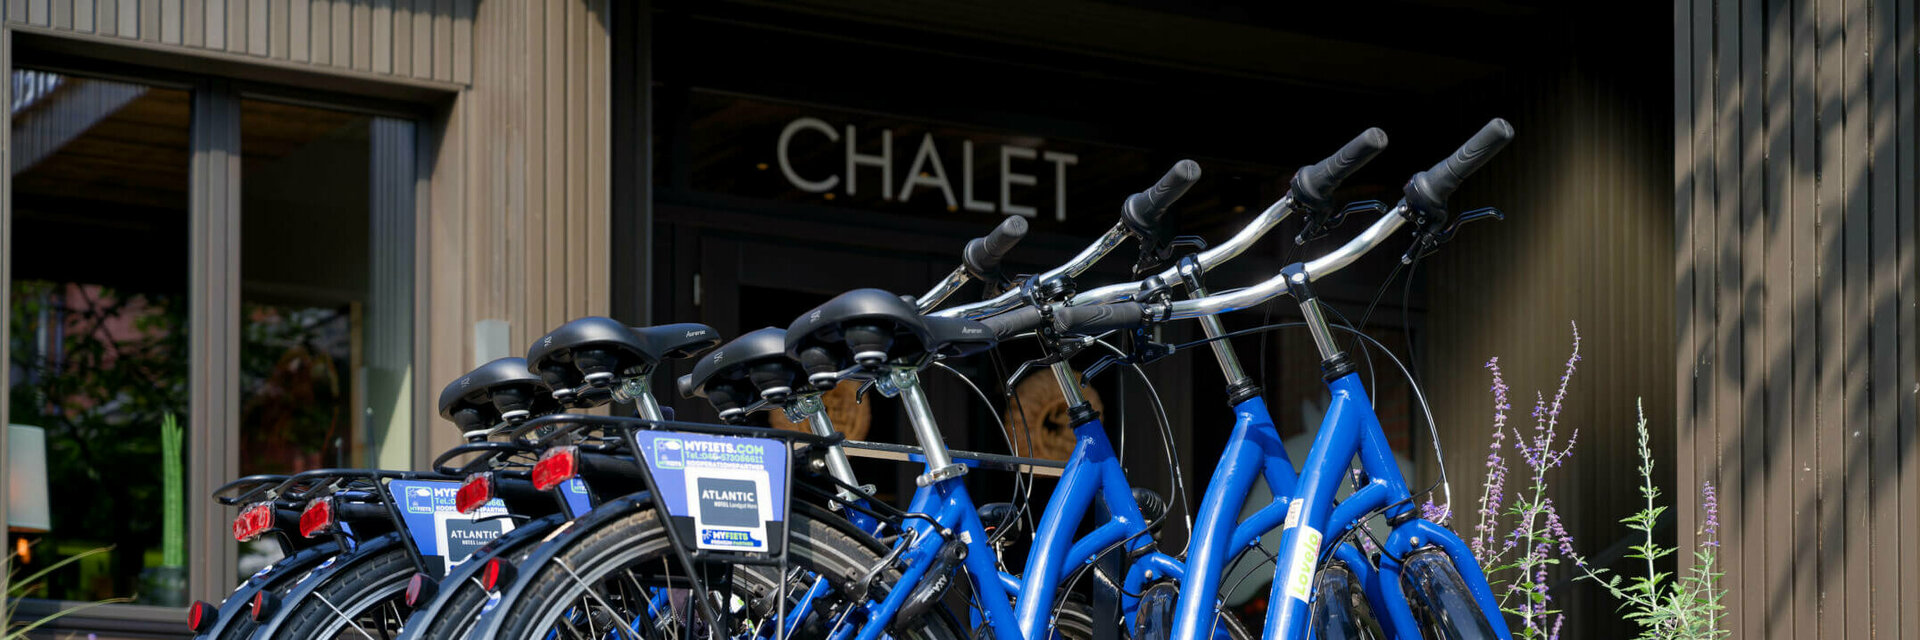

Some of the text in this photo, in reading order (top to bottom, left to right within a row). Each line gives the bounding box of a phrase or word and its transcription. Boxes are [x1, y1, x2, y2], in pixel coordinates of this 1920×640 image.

[777, 117, 1078, 221] CHALET
[684, 440, 764, 455] MYFIETS.COM
[702, 489, 755, 502] ATLANTIC
[450, 529, 499, 540] ATLANTIC
[712, 531, 749, 541] MYFIETS
[1293, 533, 1319, 596] Lovelo
